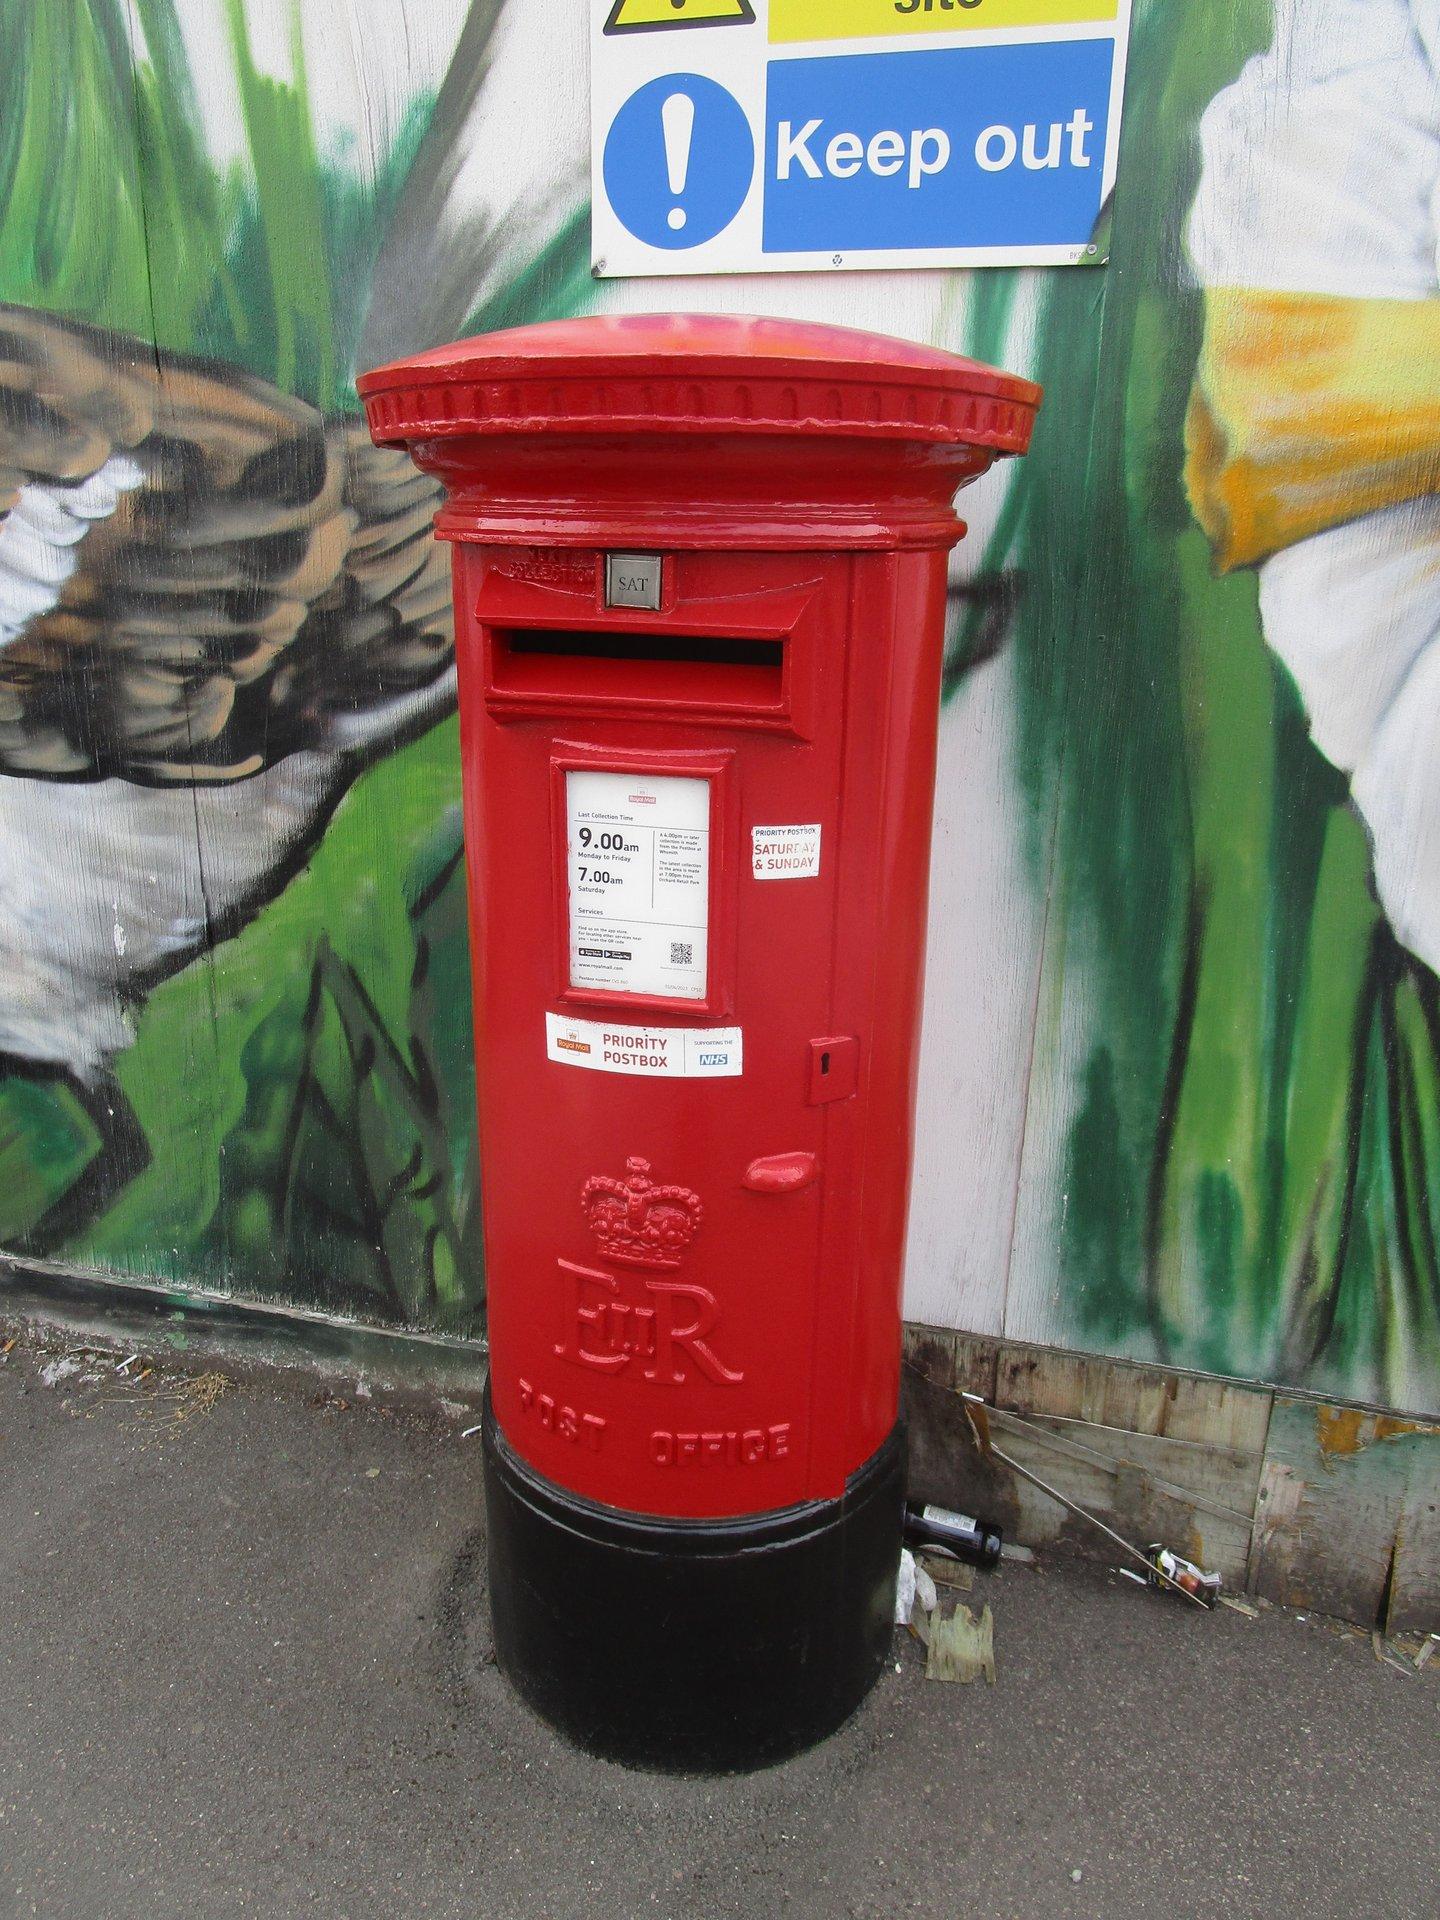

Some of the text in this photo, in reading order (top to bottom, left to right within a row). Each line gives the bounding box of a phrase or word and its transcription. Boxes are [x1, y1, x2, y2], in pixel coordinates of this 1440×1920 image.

[776, 108, 1094, 189] Keep out
[618, 577, 649, 592] SAT
[592, 812, 618, 820] Collection
[578, 827, 639, 852] 9.00am
[578, 852, 602, 861] Monday
[612, 854, 632, 863] Friday
[755, 857, 814, 870] & SUNDAY
[578, 867, 623, 885] 7.00am
[578, 885, 605, 895] Saturday
[578, 907, 604, 916] Services
[558, 1039, 575, 1049] Royal
[603, 1033, 667, 1050] PRIORITY
[603, 1051, 668, 1068] POSTBOX
[700, 1054, 727, 1065] NHS
[519, 1377, 791, 1466] POST OFFICE
